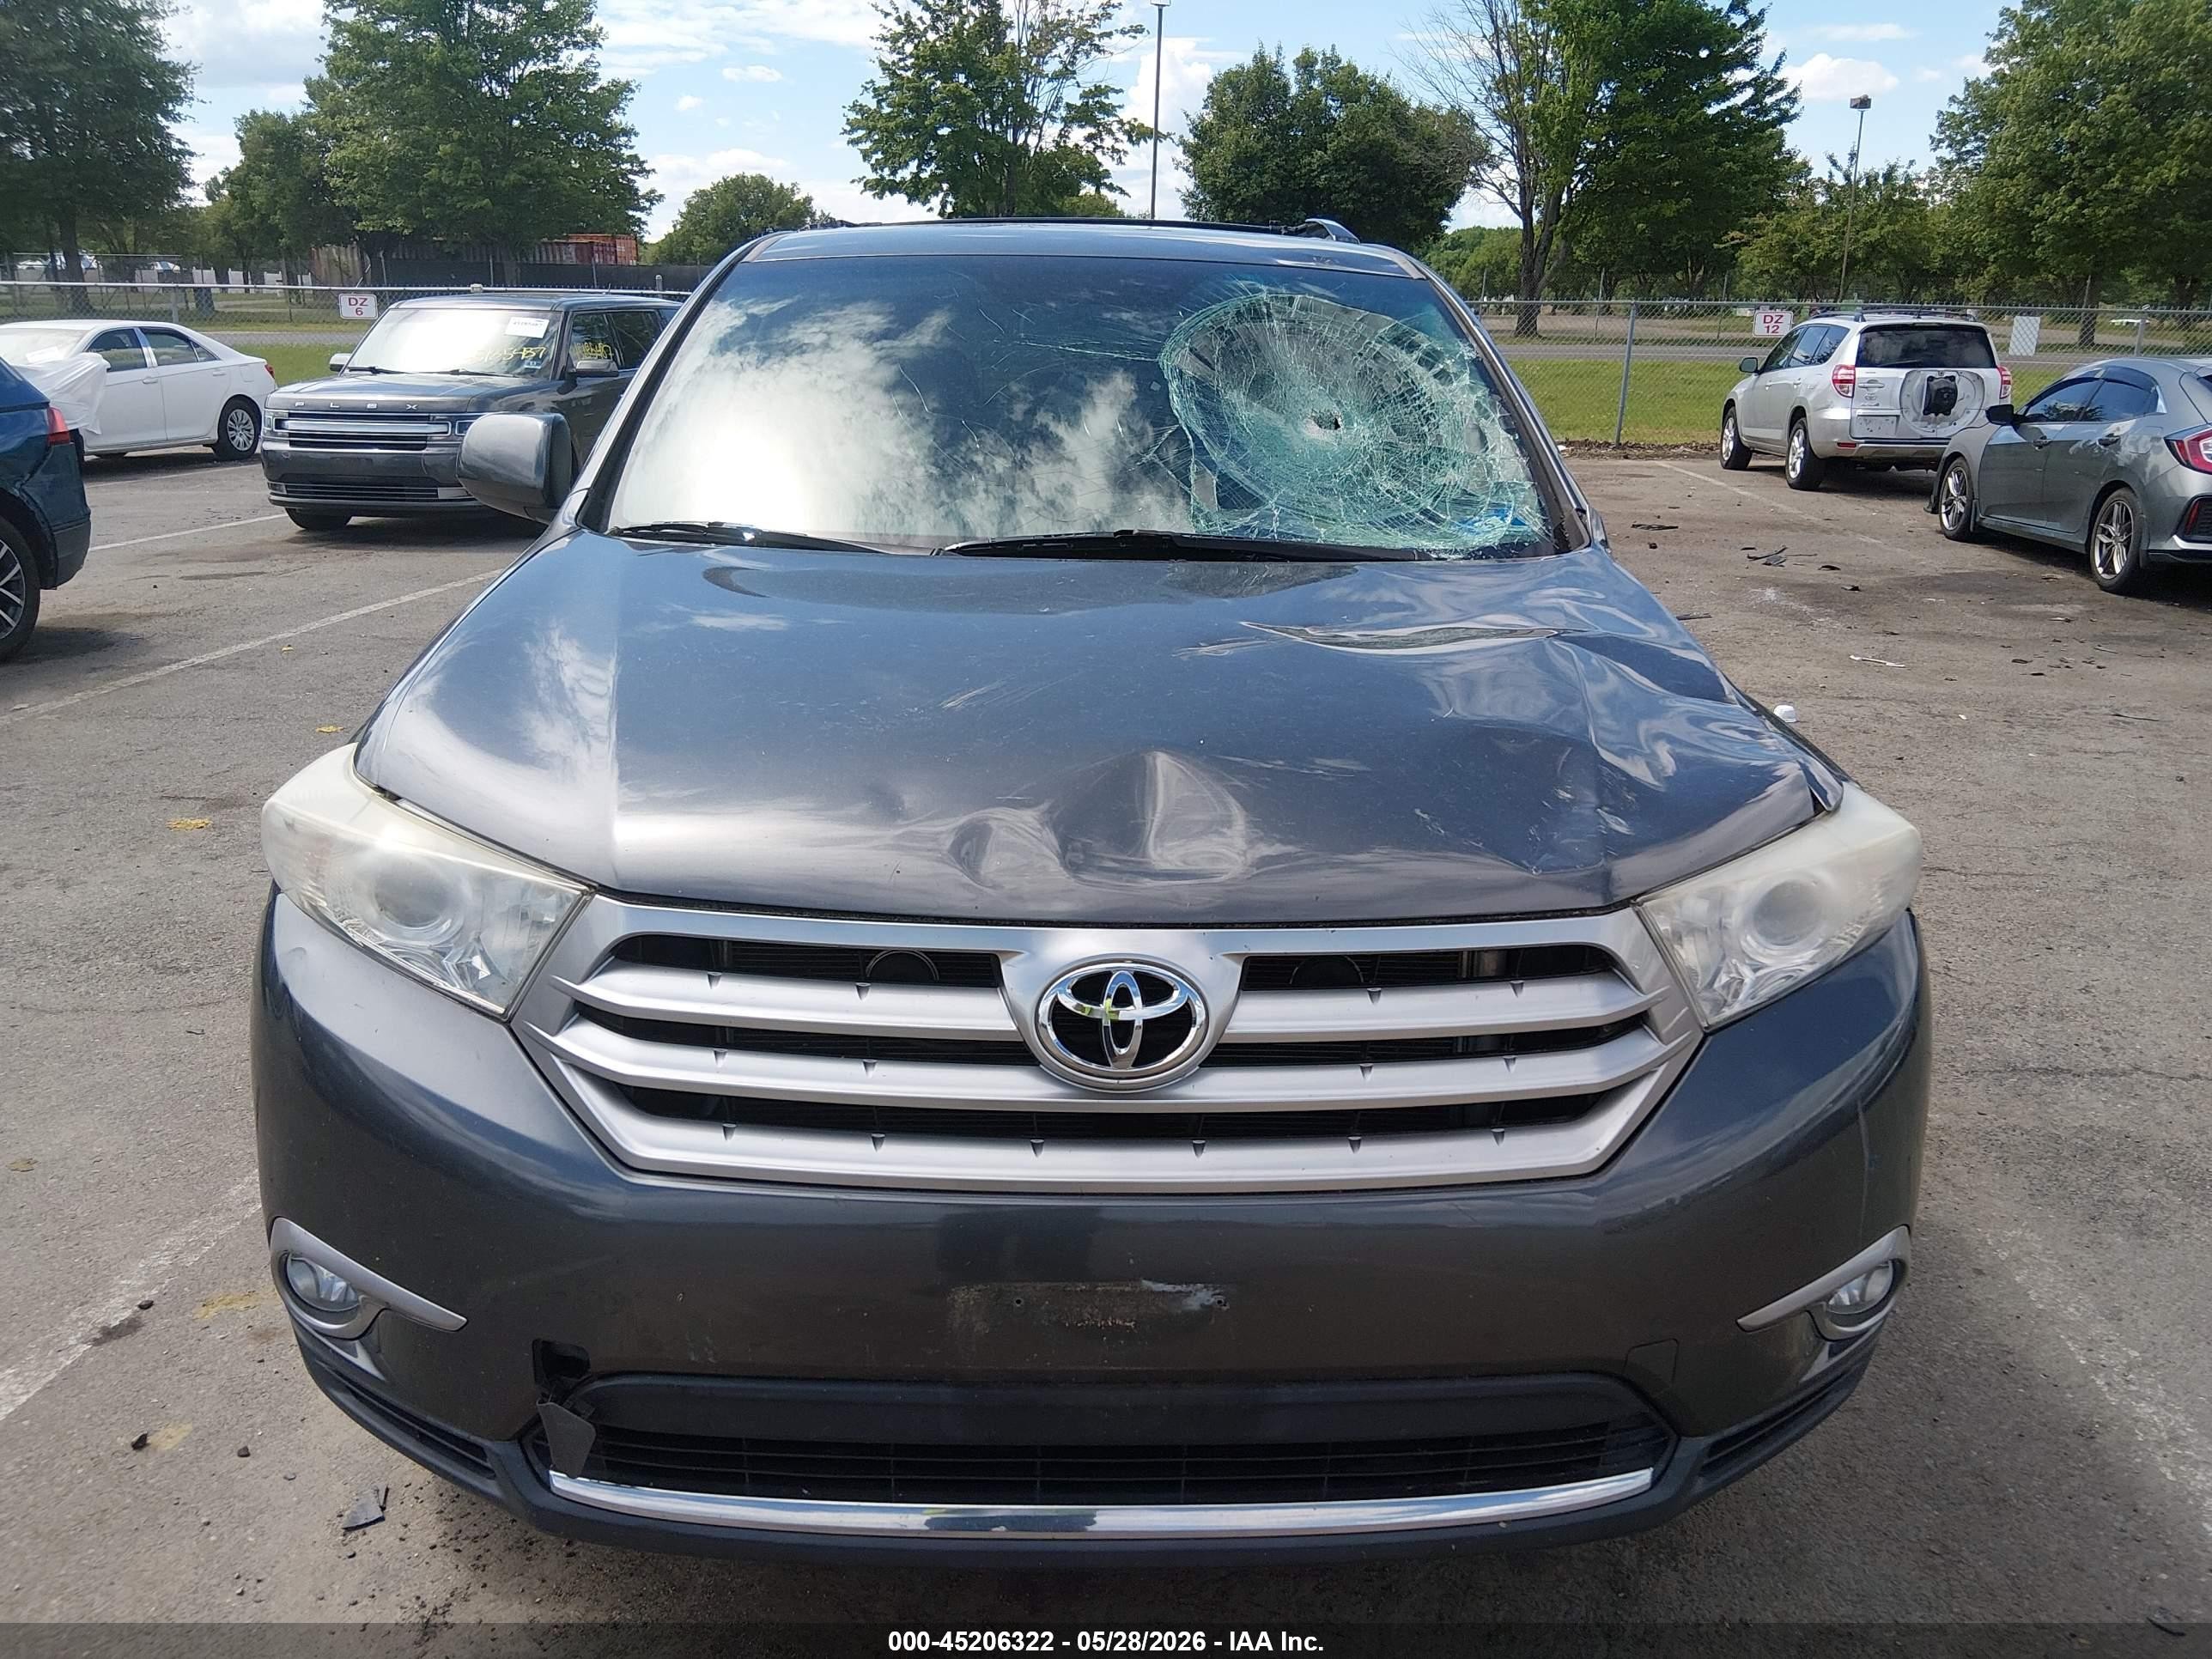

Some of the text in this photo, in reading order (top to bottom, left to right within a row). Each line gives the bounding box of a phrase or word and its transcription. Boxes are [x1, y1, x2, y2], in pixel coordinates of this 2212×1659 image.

[348, 297, 368, 307] DZ
[355, 307, 364, 316] 6
[1763, 314, 1784, 324] DZ
[1765, 325, 1780, 334] 12
